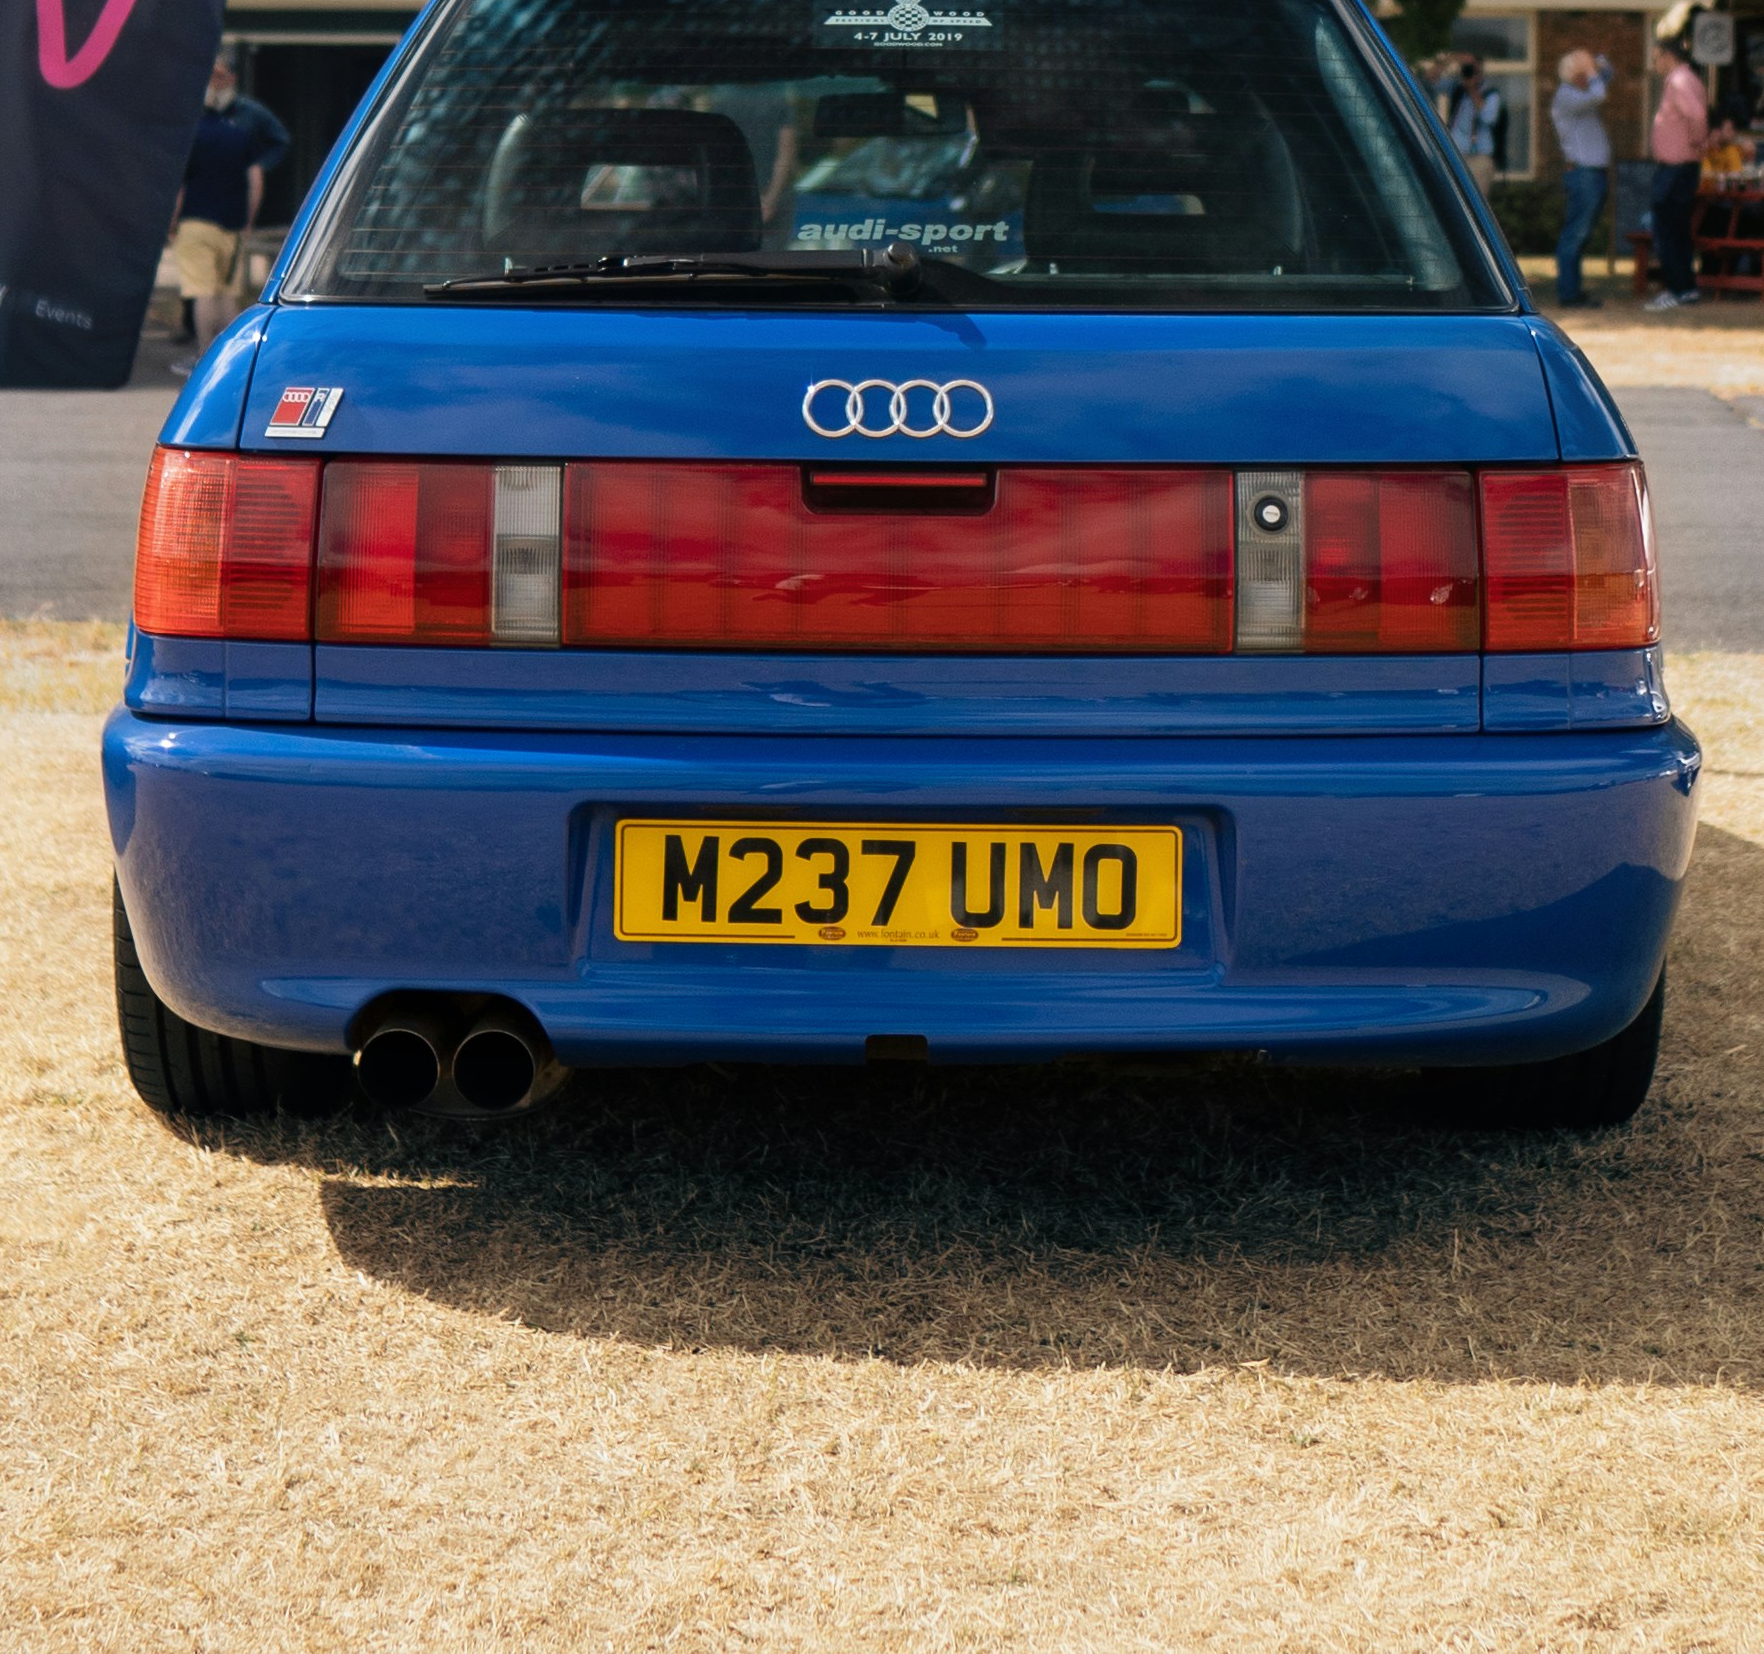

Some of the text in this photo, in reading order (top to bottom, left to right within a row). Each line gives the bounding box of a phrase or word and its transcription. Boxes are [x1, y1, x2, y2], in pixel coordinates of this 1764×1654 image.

[853, 32, 964, 42] 4-7 JULY 2019
[797, 218, 1010, 246] audi-sport
[928, 245, 958, 253] .net
[35, 298, 93, 330] Events
[662, 834, 1138, 930] M237 UMO
